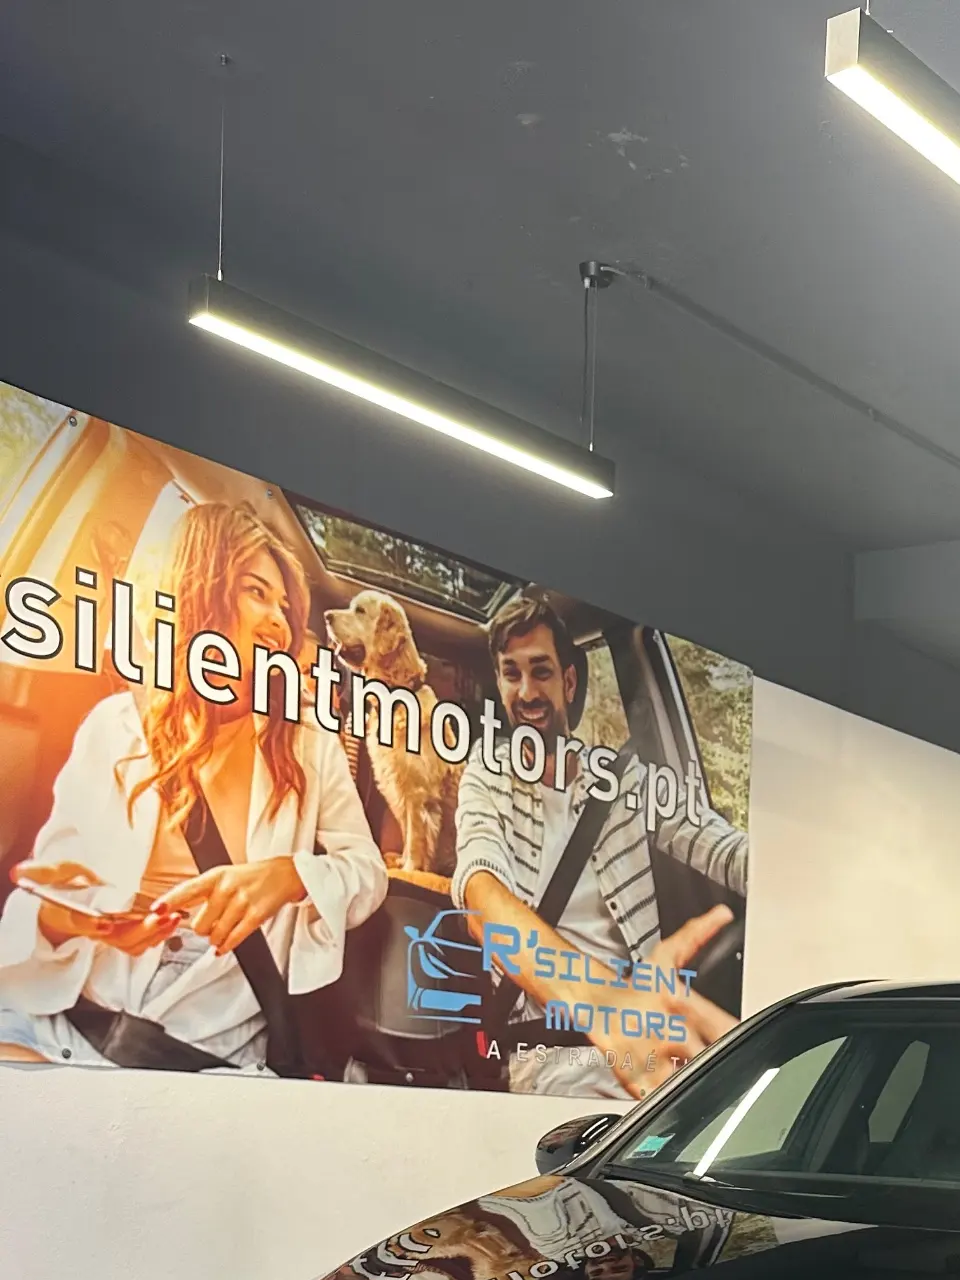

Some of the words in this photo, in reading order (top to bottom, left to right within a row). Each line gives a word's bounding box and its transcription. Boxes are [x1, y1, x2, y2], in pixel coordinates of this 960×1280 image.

[482, 922, 698, 998] R'SILIENT
[545, 999, 688, 1043] MOTORS
[486, 1039, 501, 1061] A
[516, 1042, 634, 1071] ESTRADA
